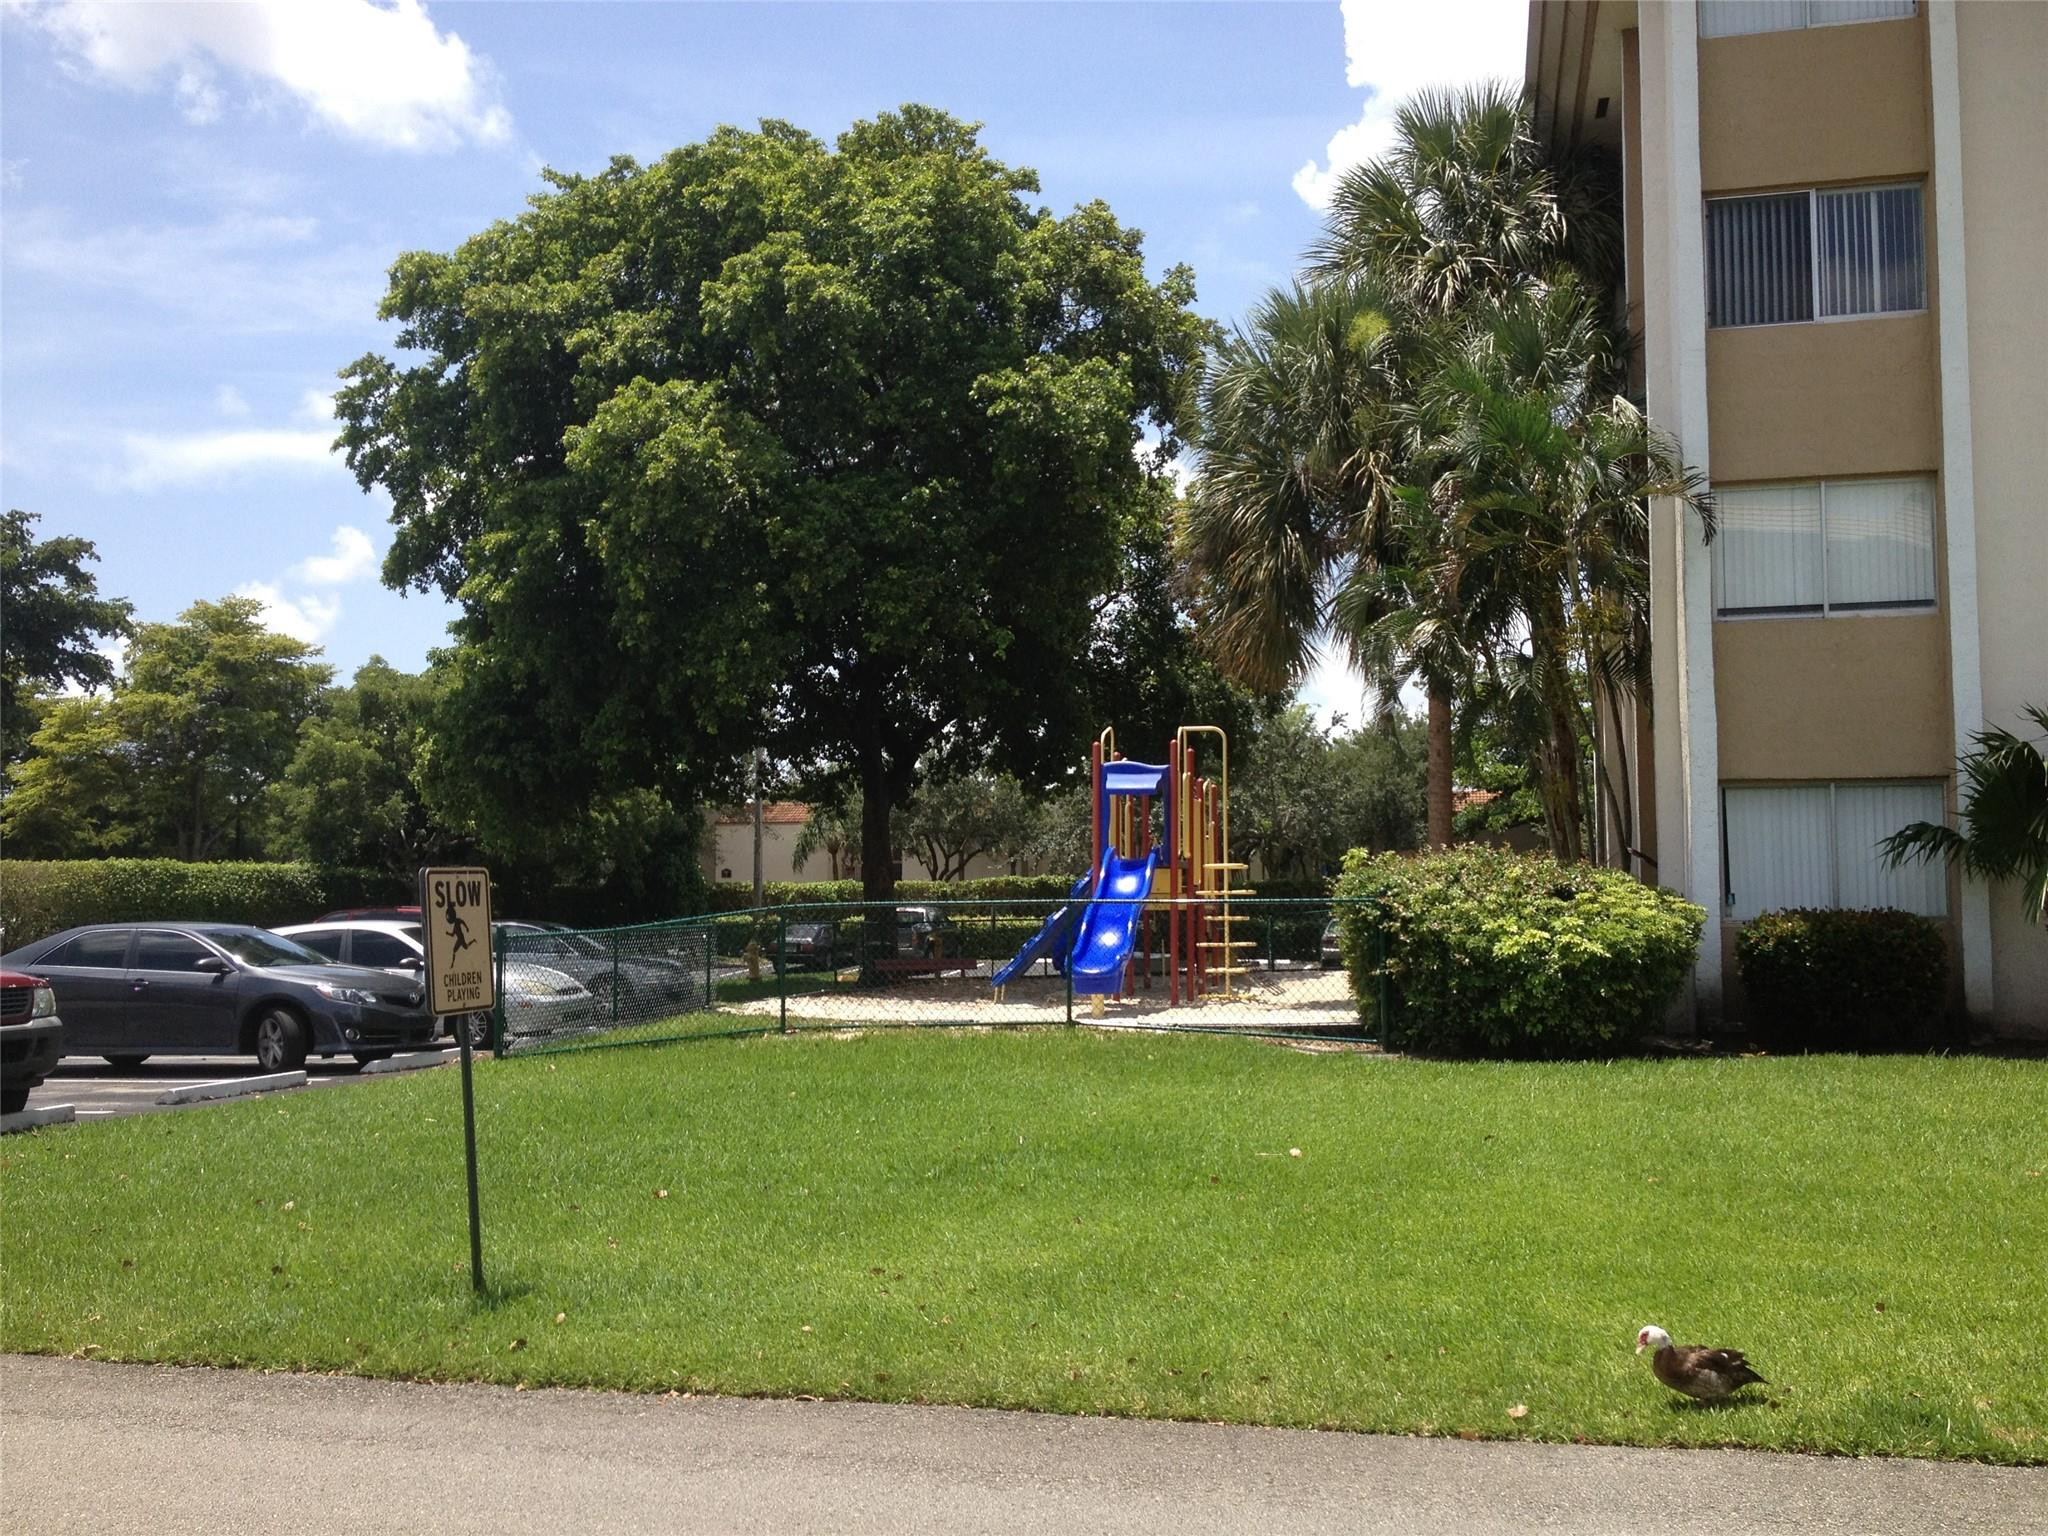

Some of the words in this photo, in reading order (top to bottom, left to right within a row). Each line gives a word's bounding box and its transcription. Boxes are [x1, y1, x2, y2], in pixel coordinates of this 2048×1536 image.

[435, 880, 481, 908] SLOW
[444, 971, 482, 987] CHILDREN
[447, 987, 480, 1002] PLAYING
